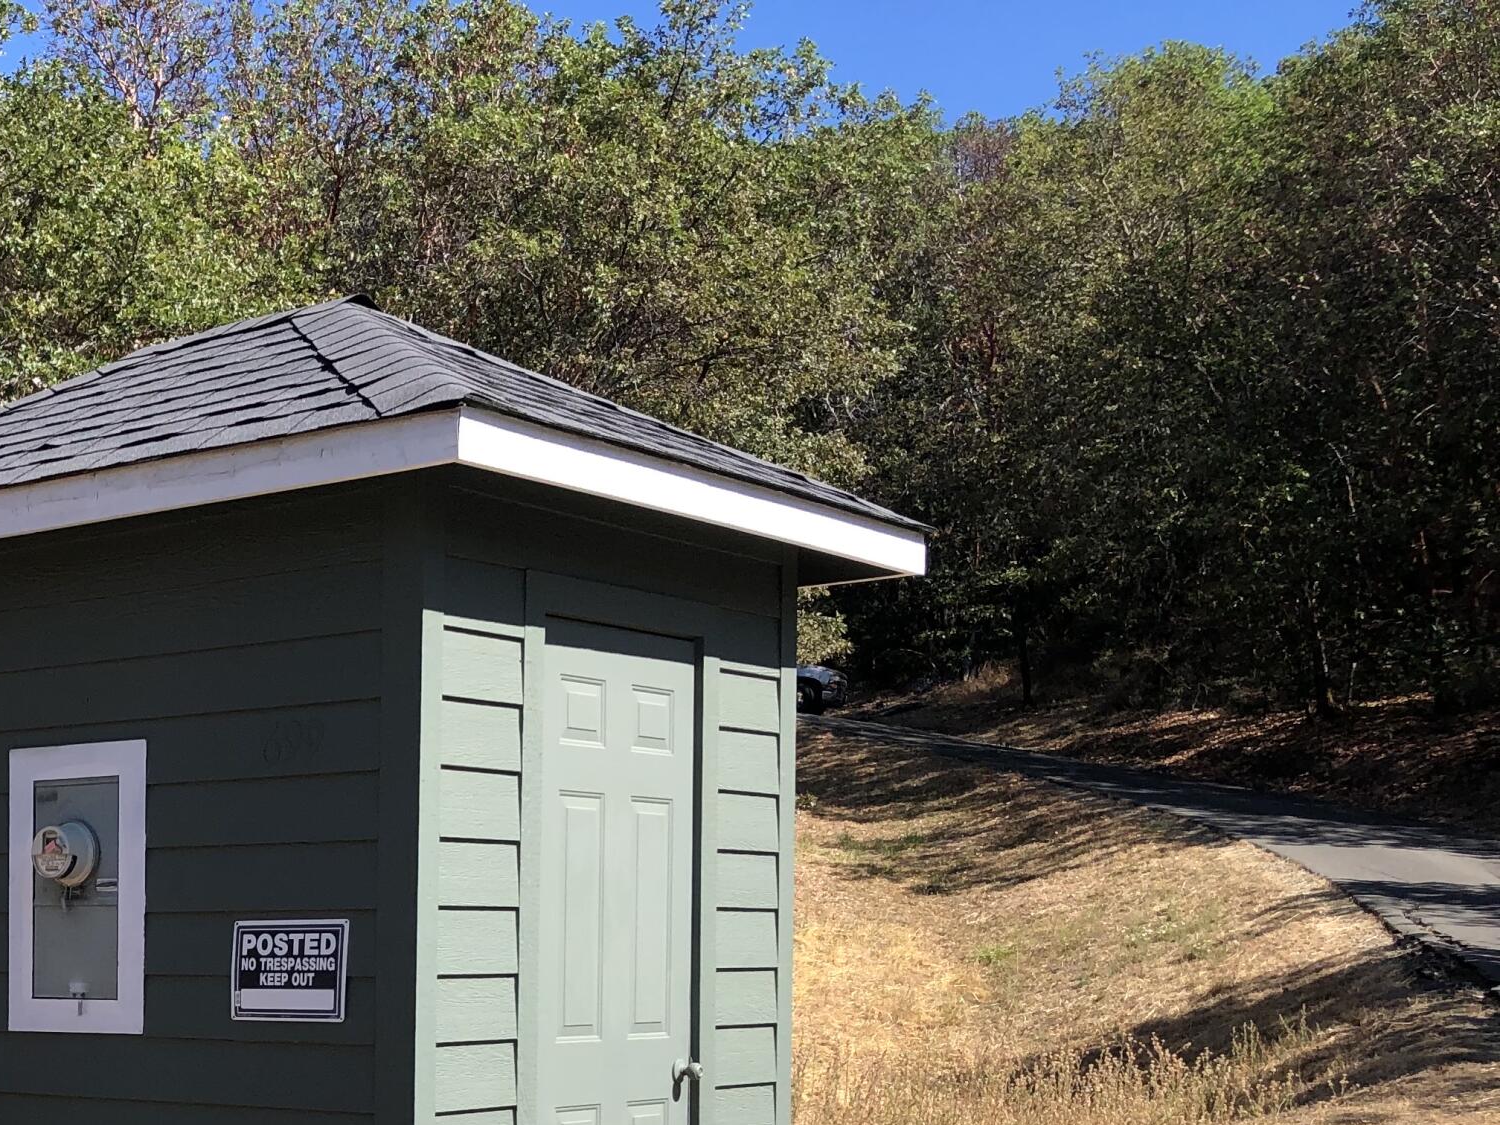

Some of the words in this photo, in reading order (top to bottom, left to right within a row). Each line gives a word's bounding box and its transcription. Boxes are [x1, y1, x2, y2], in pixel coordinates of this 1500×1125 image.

[241, 932, 336, 956] POSTED
[241, 957, 257, 971] NO
[260, 957, 335, 971] TRESPASSING
[259, 972, 288, 986] KEEP
[291, 972, 315, 986] OUT
